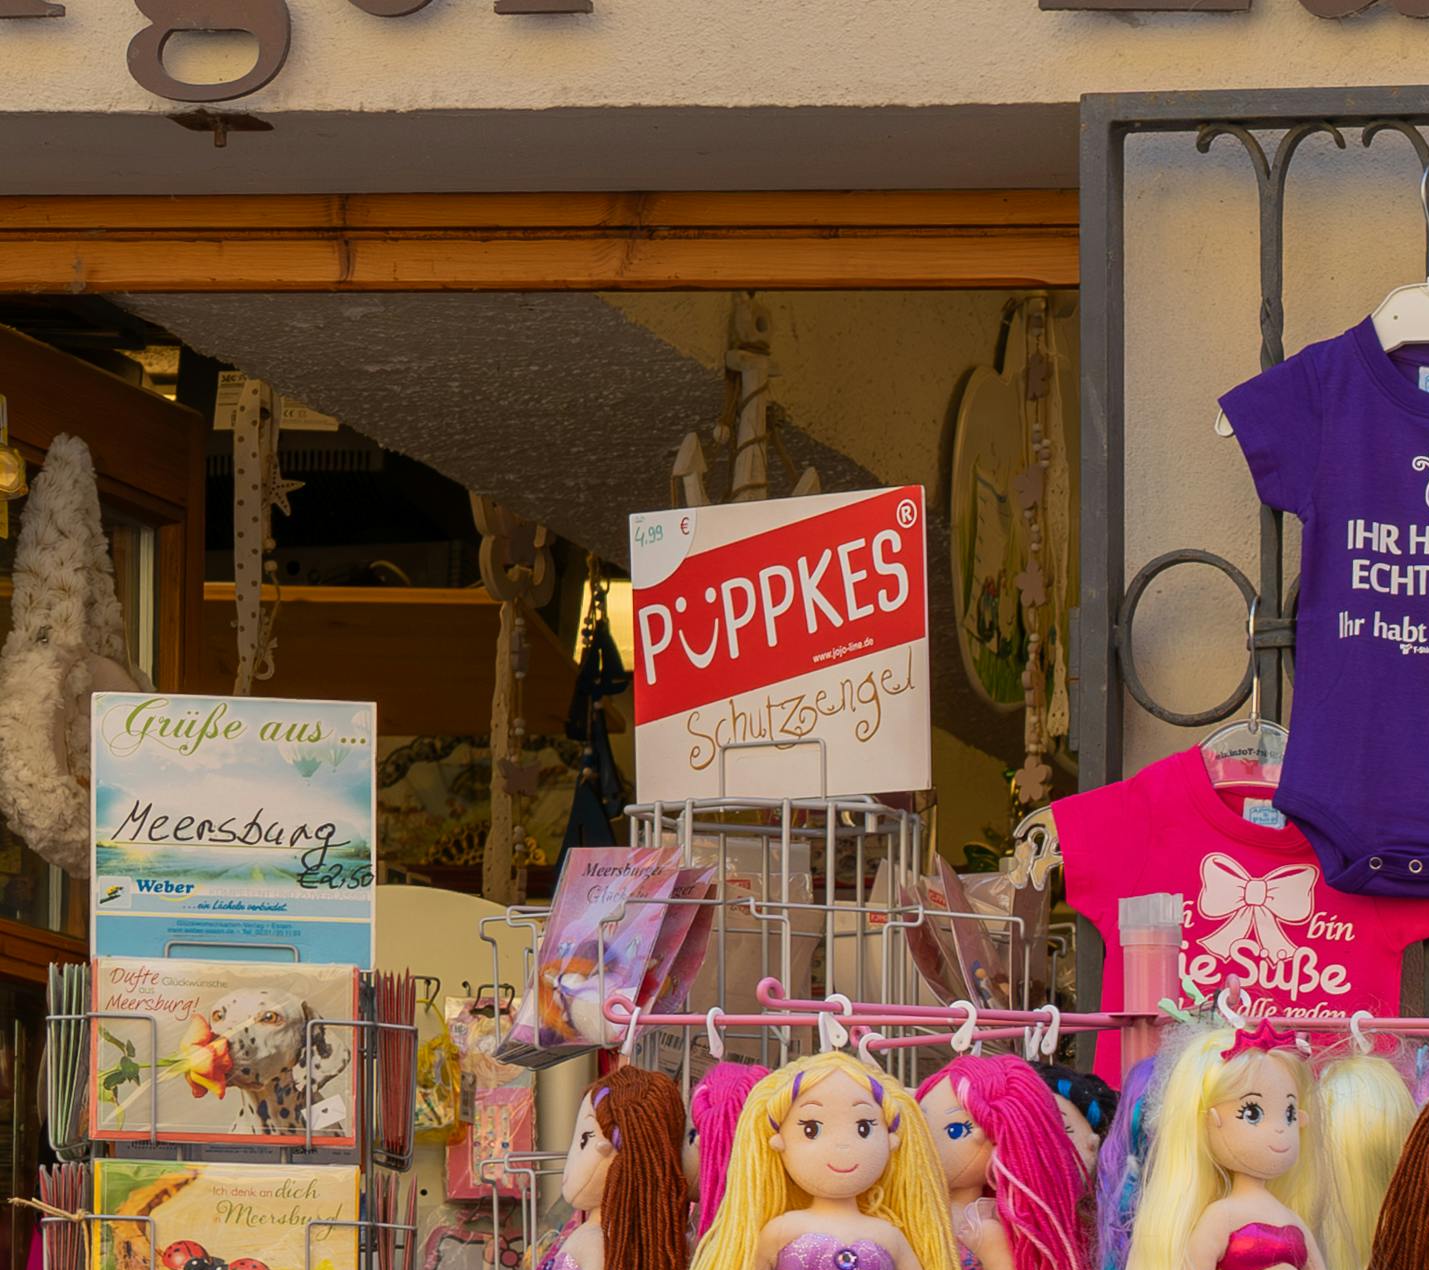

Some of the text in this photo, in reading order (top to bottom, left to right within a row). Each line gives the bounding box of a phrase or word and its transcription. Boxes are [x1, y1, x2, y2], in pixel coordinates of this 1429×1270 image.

[1347, 518, 1402, 557] IHR
[1338, 611, 1366, 640] Ihr
[1372, 612, 1428, 645] habt
[686, 645, 915, 771] Schutzengel
[102, 698, 333, 757] Grüße aus
[582, 860, 663, 877] Meersburger
[136, 878, 195, 895] Weber
[1307, 911, 1355, 942] bin
[110, 966, 160, 993] Dufte
[1178, 938, 1352, 1001] ie Süße
[104, 994, 200, 1021] Meersburg!
[212, 1178, 320, 1200] Ich denk an dich
[216, 1199, 343, 1240] Meersburg!
